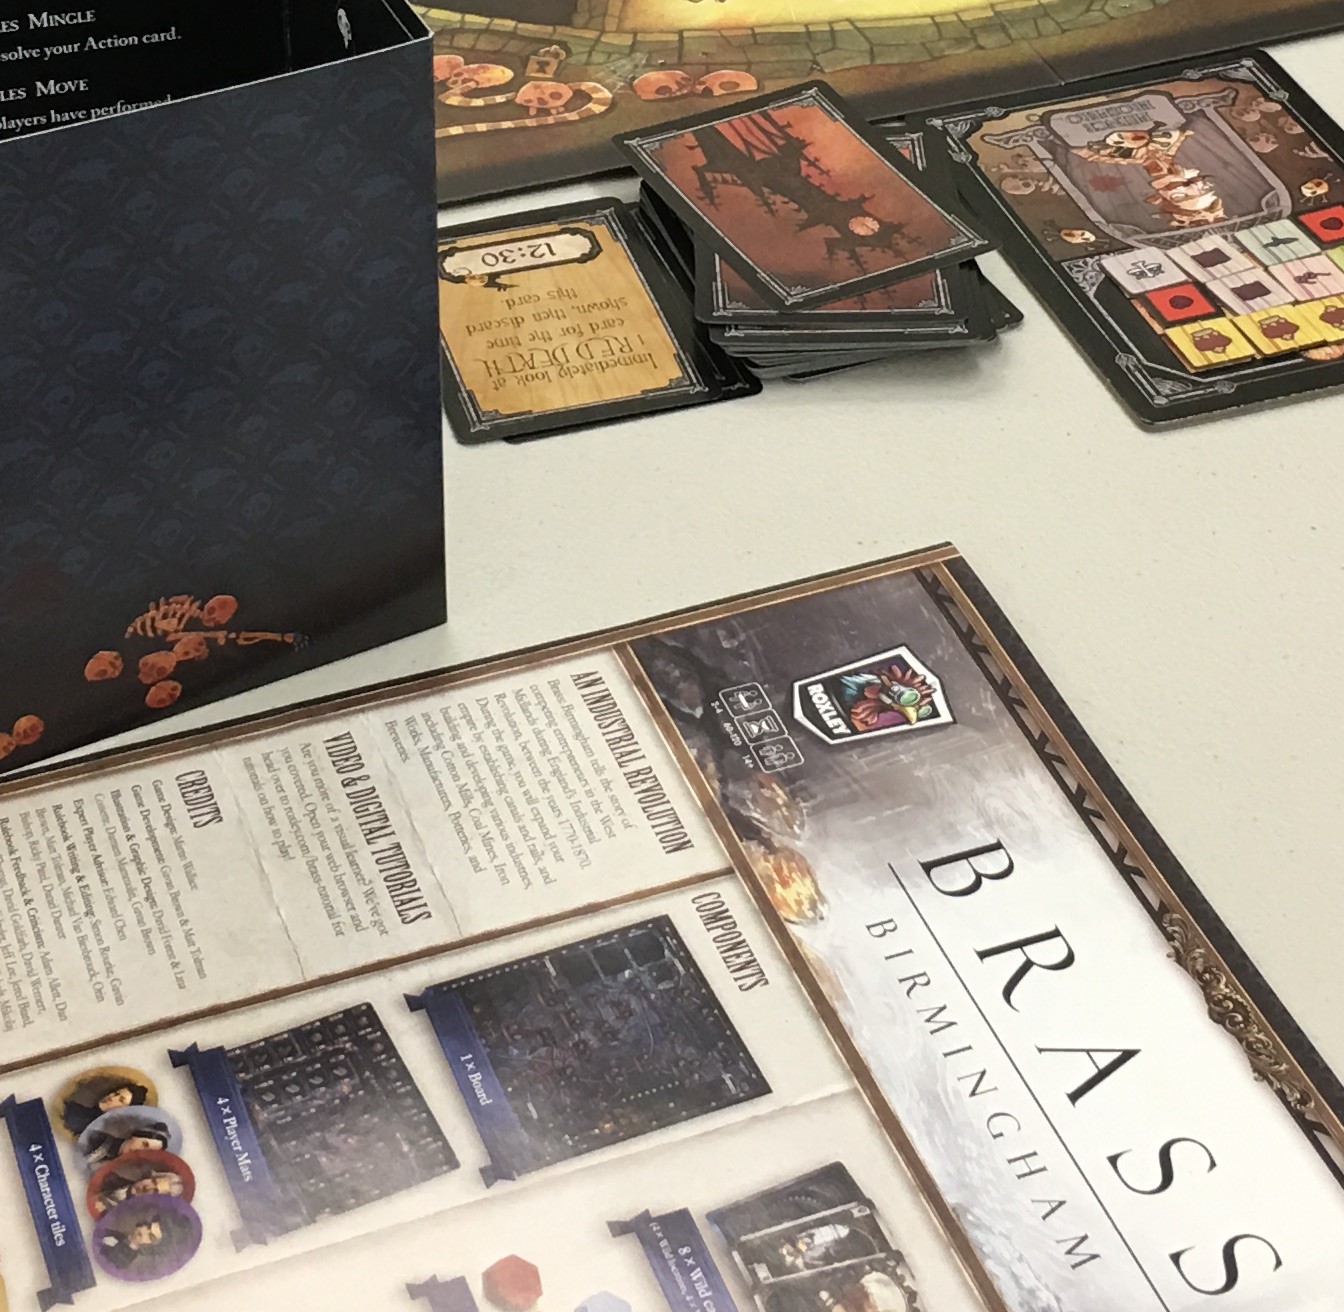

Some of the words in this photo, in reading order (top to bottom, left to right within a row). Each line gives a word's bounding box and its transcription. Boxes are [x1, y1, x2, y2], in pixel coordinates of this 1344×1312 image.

[27, 9, 95, 29] MINGLE
[42, 41, 81, 61] your
[83, 34, 139, 51] Action
[141, 25, 181, 44] card.
[34, 78, 89, 97] MOVE
[50, 109, 87, 124] have
[90, 93, 172, 121] perform
[480, 240, 558, 268] 12:30
[499, 292, 541, 310] card.
[547, 285, 579, 301] this
[464, 314, 526, 336] discard
[531, 305, 567, 323] then
[588, 317, 625, 334] card
[485, 335, 523, 351] time
[526, 330, 553, 346] the
[559, 323, 584, 340] for
[575, 335, 634, 360] RED
[473, 343, 570, 378] DEATH
[556, 350, 659, 381] Immediately
[490, 375, 508, 392] at
[515, 369, 552, 387] look
[569, 670, 605, 690] AN
[806, 682, 853, 736] ROXLEY
[580, 687, 645, 768] INDUSTRIAL
[260, 749, 281, 774] head
[279, 745, 293, 764] you
[322, 730, 365, 774] VIDEO
[270, 772, 286, 794] over
[339, 773, 371, 789] &
[174, 769, 223, 828] CREDITS
[278, 793, 290, 806] to
[622, 765, 694, 854] REVOLUTION
[301, 801, 321, 830] Open
[345, 785, 395, 845] DIGITAL
[309, 829, 331, 852] your
[324, 851, 342, 873] web
[332, 871, 357, 912] browser
[370, 841, 432, 924] TUTORIALS
[330, 920, 346, 937] for
[348, 912, 370, 933] and
[690, 890, 770, 993] COMPONENTS
[919, 837, 1284, 1297] BRASS
[468, 1072, 494, 1107] Board
[864, 916, 1102, 1272] BIRMINGHAM
[223, 1115, 243, 1154] Player
[235, 1153, 254, 1183] Mats
[33, 1162, 63, 1222] Character
[48, 1222, 67, 1248] tiles
